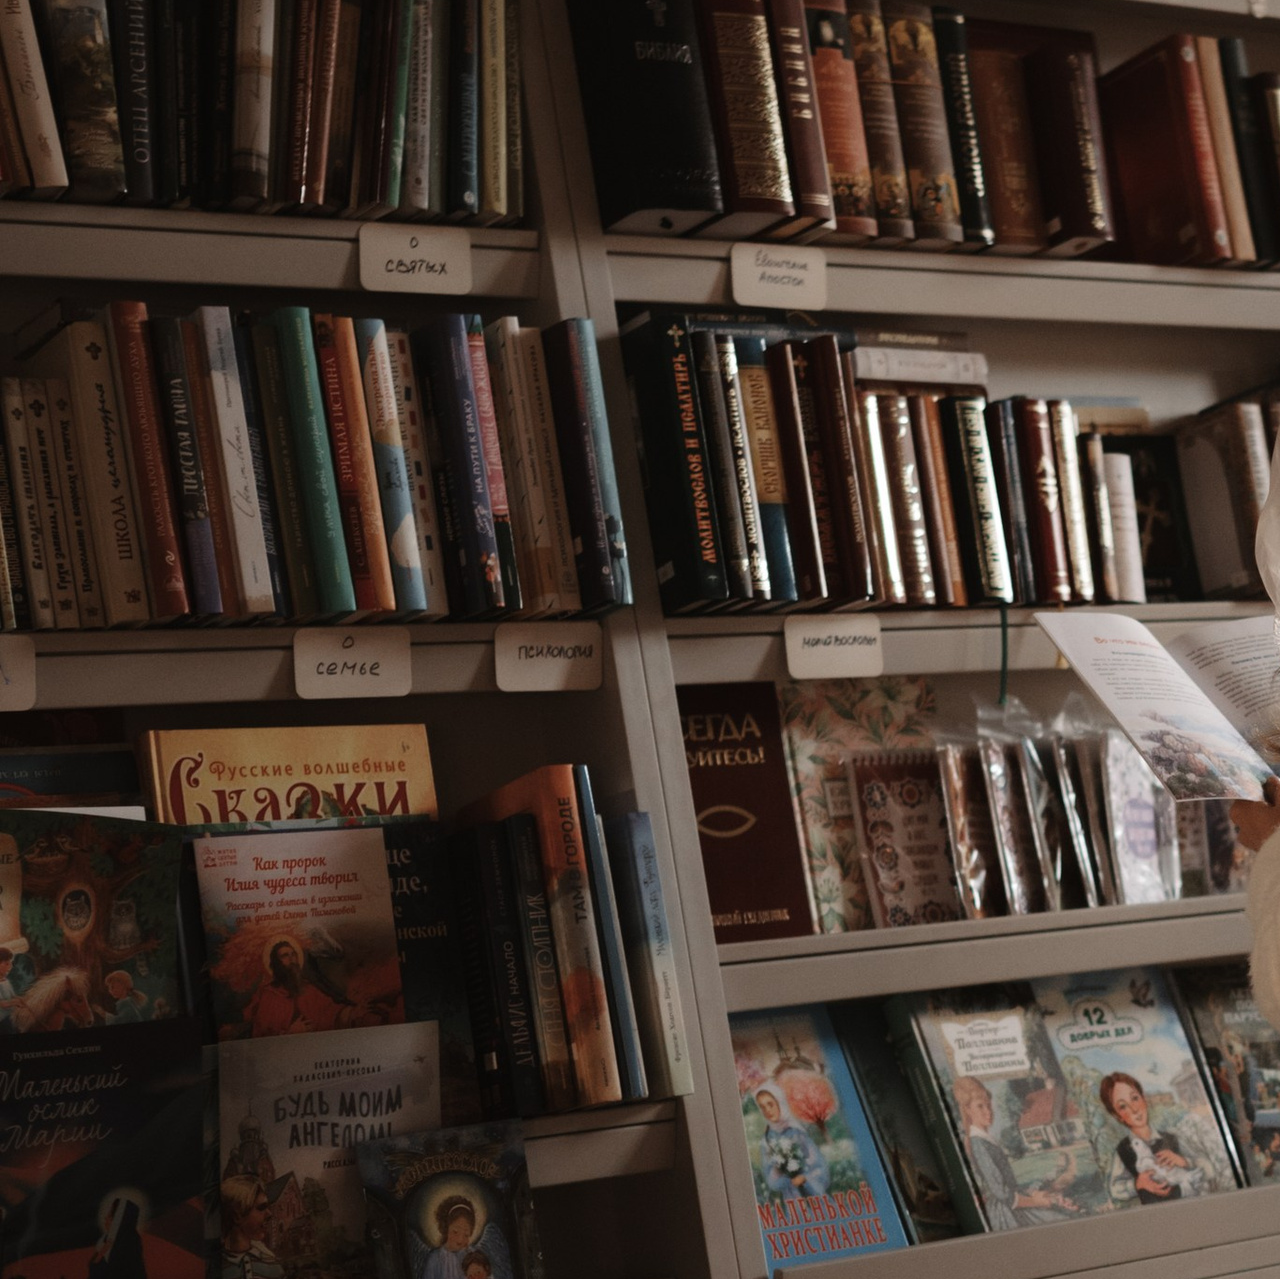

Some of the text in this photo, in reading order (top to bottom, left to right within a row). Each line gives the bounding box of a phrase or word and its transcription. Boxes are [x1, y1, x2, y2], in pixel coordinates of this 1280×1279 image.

[635, 40, 694, 65] БИБЛИЯ
[130, 106, 151, 164] ОТЕЦ
[169, 377, 187, 427] ТАЙНА
[672, 354, 698, 433] ПСАЛТИРЬ
[323, 356, 354, 483] ЗРИМАЯ ИСТИНА
[462, 396, 477, 434] БРАКУ
[126, 339, 167, 538] РАДОСТЬ КРОТКОГО ЛЮБЯЩЕГО ДУХА
[92, 381, 134, 562] ШКОЛА целомудрия
[179, 431, 200, 497] ПРОСТАЯ
[469, 445, 482, 475] ПУТИ
[691, 453, 719, 564] МОЛИТВОСЛОВ
[739, 457, 759, 545] МОЛИТВОСЛОВ
[347, 504, 364, 556] АЛЕКСЕЕВ
[208, 757, 407, 781] Русские волшебные
[688, 746, 765, 769] УЙТЕСЬ!
[556, 795, 579, 867] ГОРОДЕ
[224, 872, 359, 895] Илия чудеса творил
[252, 856, 327, 874] Как пророк
[226, 900, 265, 913] Рассказы
[254, 911, 281, 924] детей
[569, 884, 589, 925] ТАМ
[525, 890, 557, 992] СТОЛПНИК
[501, 939, 520, 996] НАЧАЛО
[1082, 1007, 1107, 1026] 12
[0, 1063, 129, 1102] Маленький
[273, 1083, 402, 1122] БУДЬ МОИМ
[28, 1098, 100, 1122] ослик
[0, 1122, 113, 1160] Марии
[758, 1181, 879, 1230] МАЛЕНЬКОЙ
[766, 1217, 888, 1261] ХРИСТИАНКЕ
